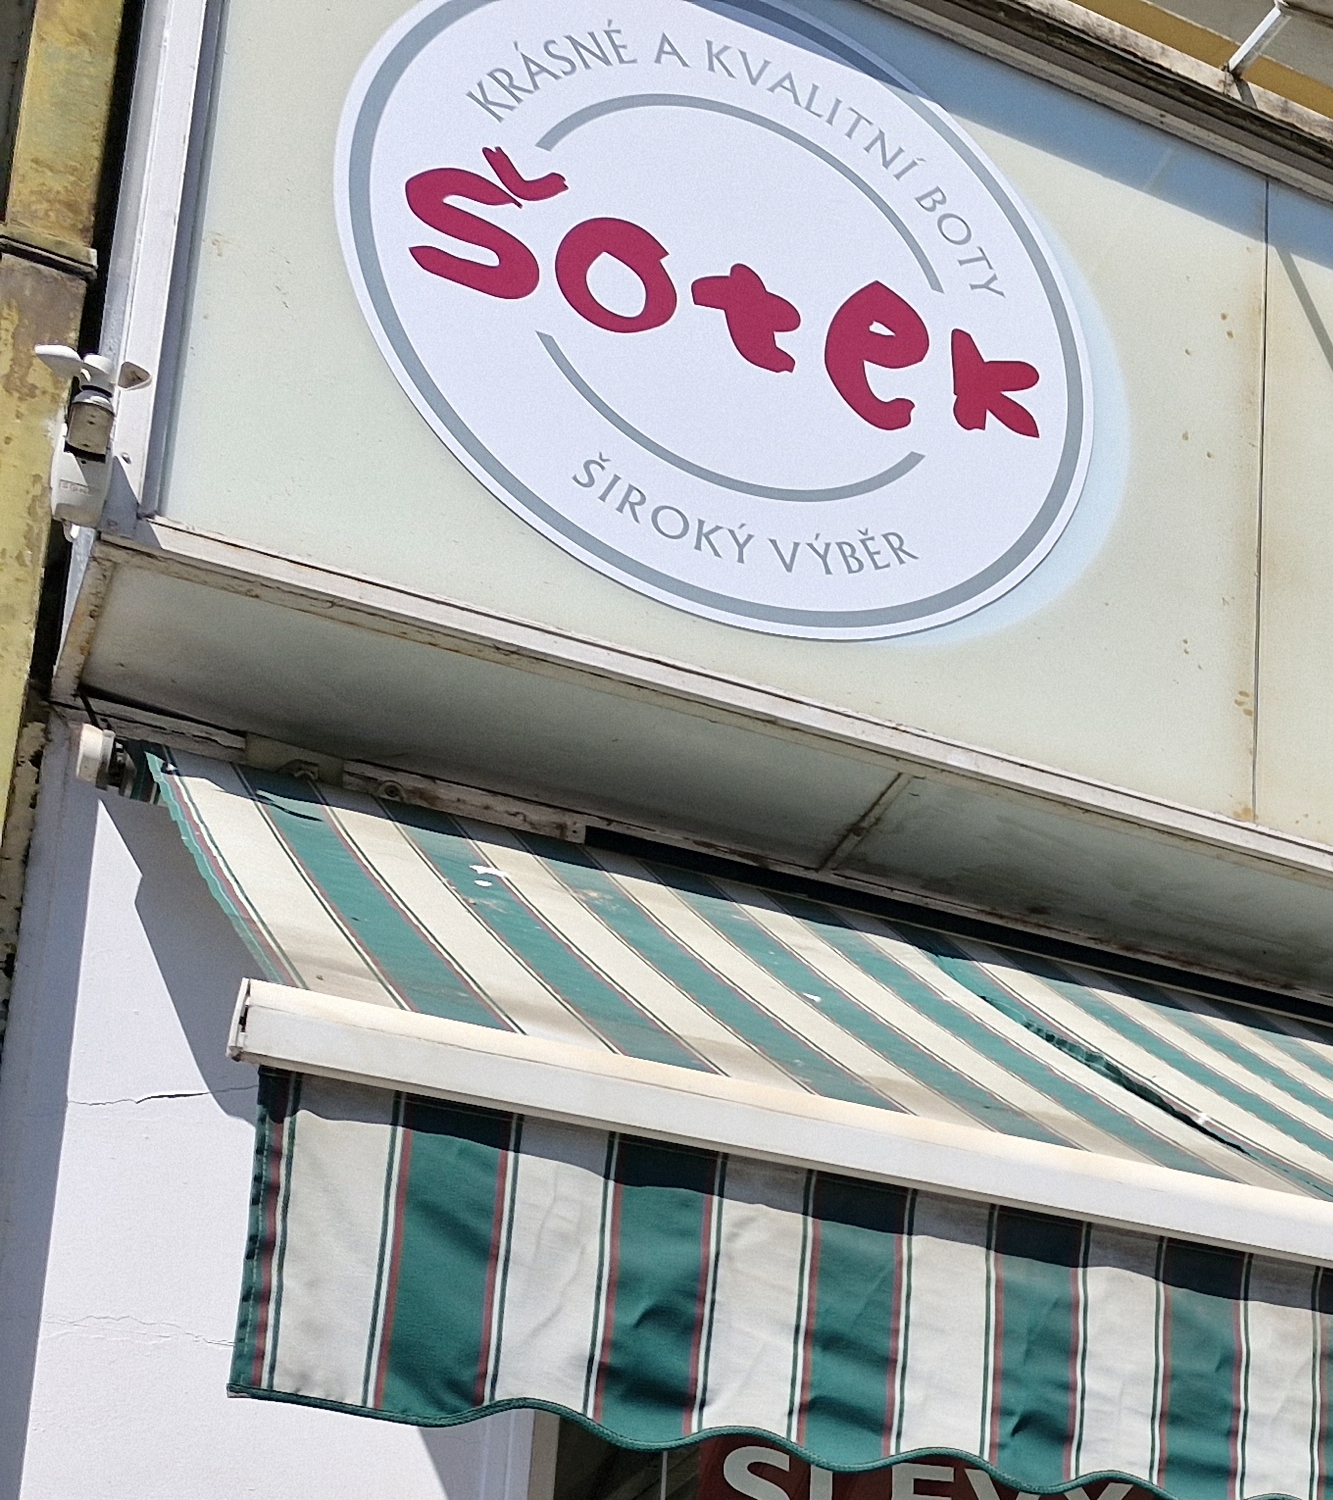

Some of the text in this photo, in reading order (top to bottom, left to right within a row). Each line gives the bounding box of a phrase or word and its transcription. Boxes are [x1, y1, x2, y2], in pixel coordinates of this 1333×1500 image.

[405, 146, 1040, 438] Šotek
[466, 20, 1005, 298] KRÁSNÉ A KVALITNÍ BOTY
[571, 451, 919, 577] ŠIROKÝ VÝBĚR
